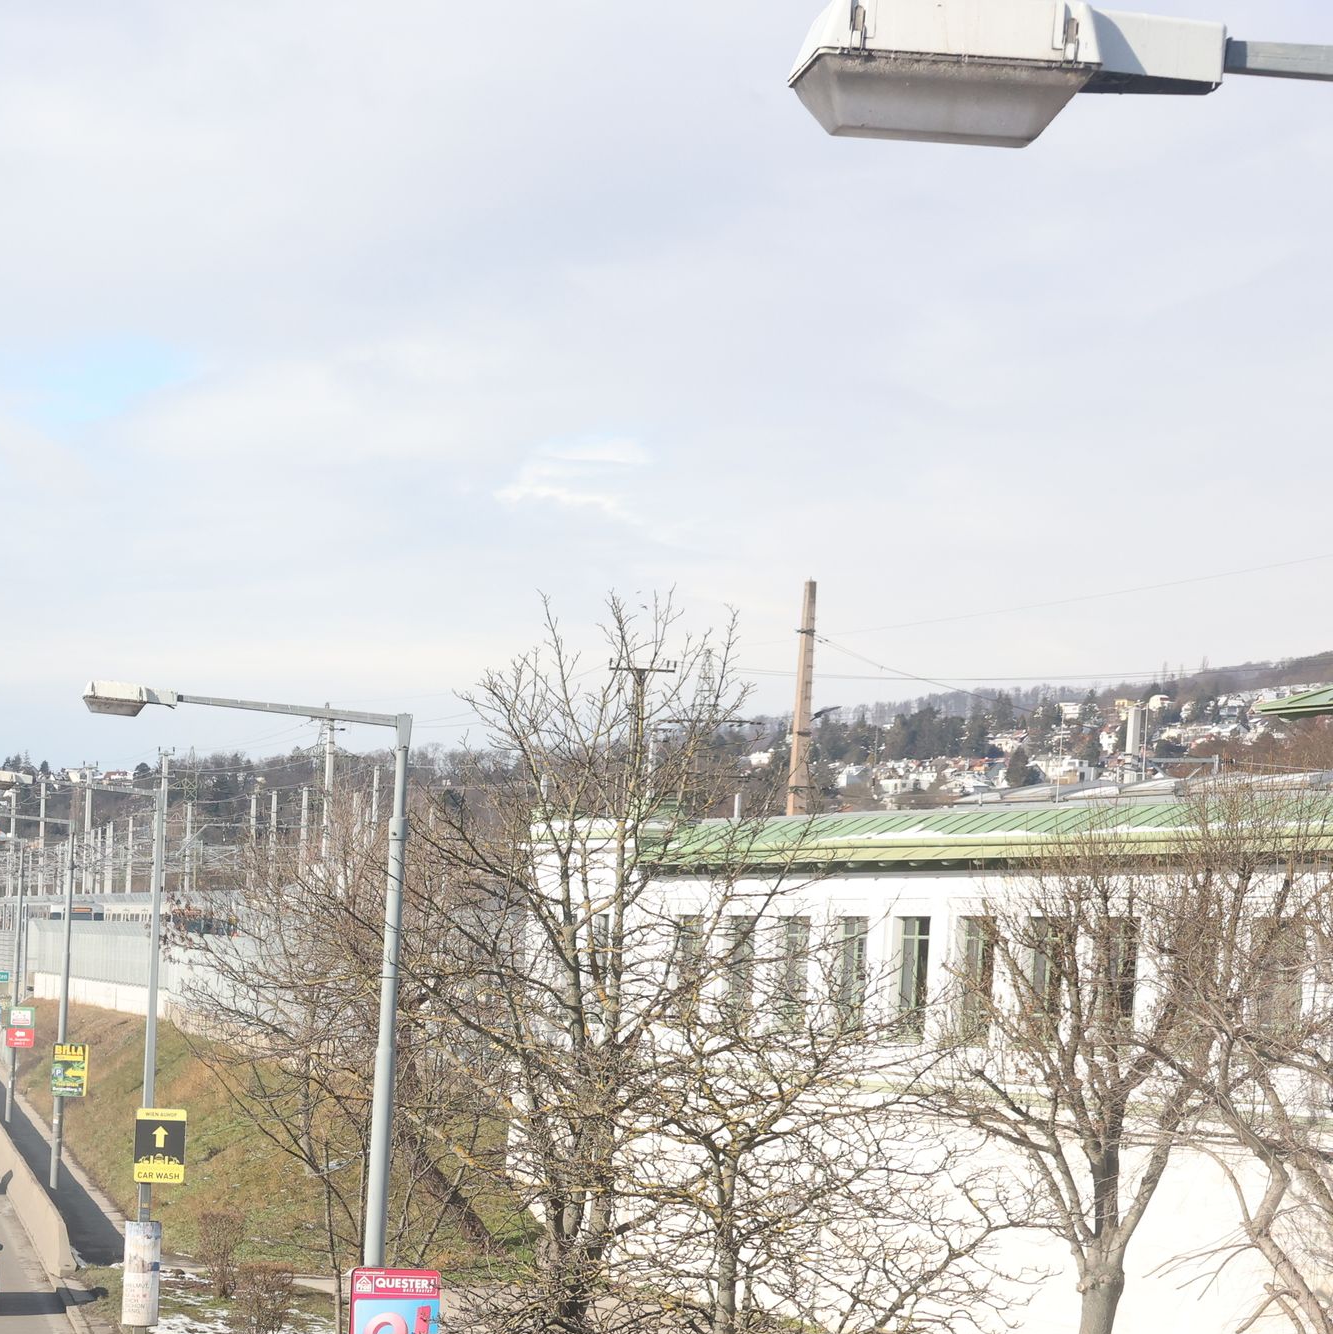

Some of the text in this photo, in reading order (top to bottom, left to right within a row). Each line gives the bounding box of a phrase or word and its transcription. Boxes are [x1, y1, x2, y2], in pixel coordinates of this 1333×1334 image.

[55, 1045, 84, 1056] BILLA
[137, 1171, 180, 1180] CAR WASH
